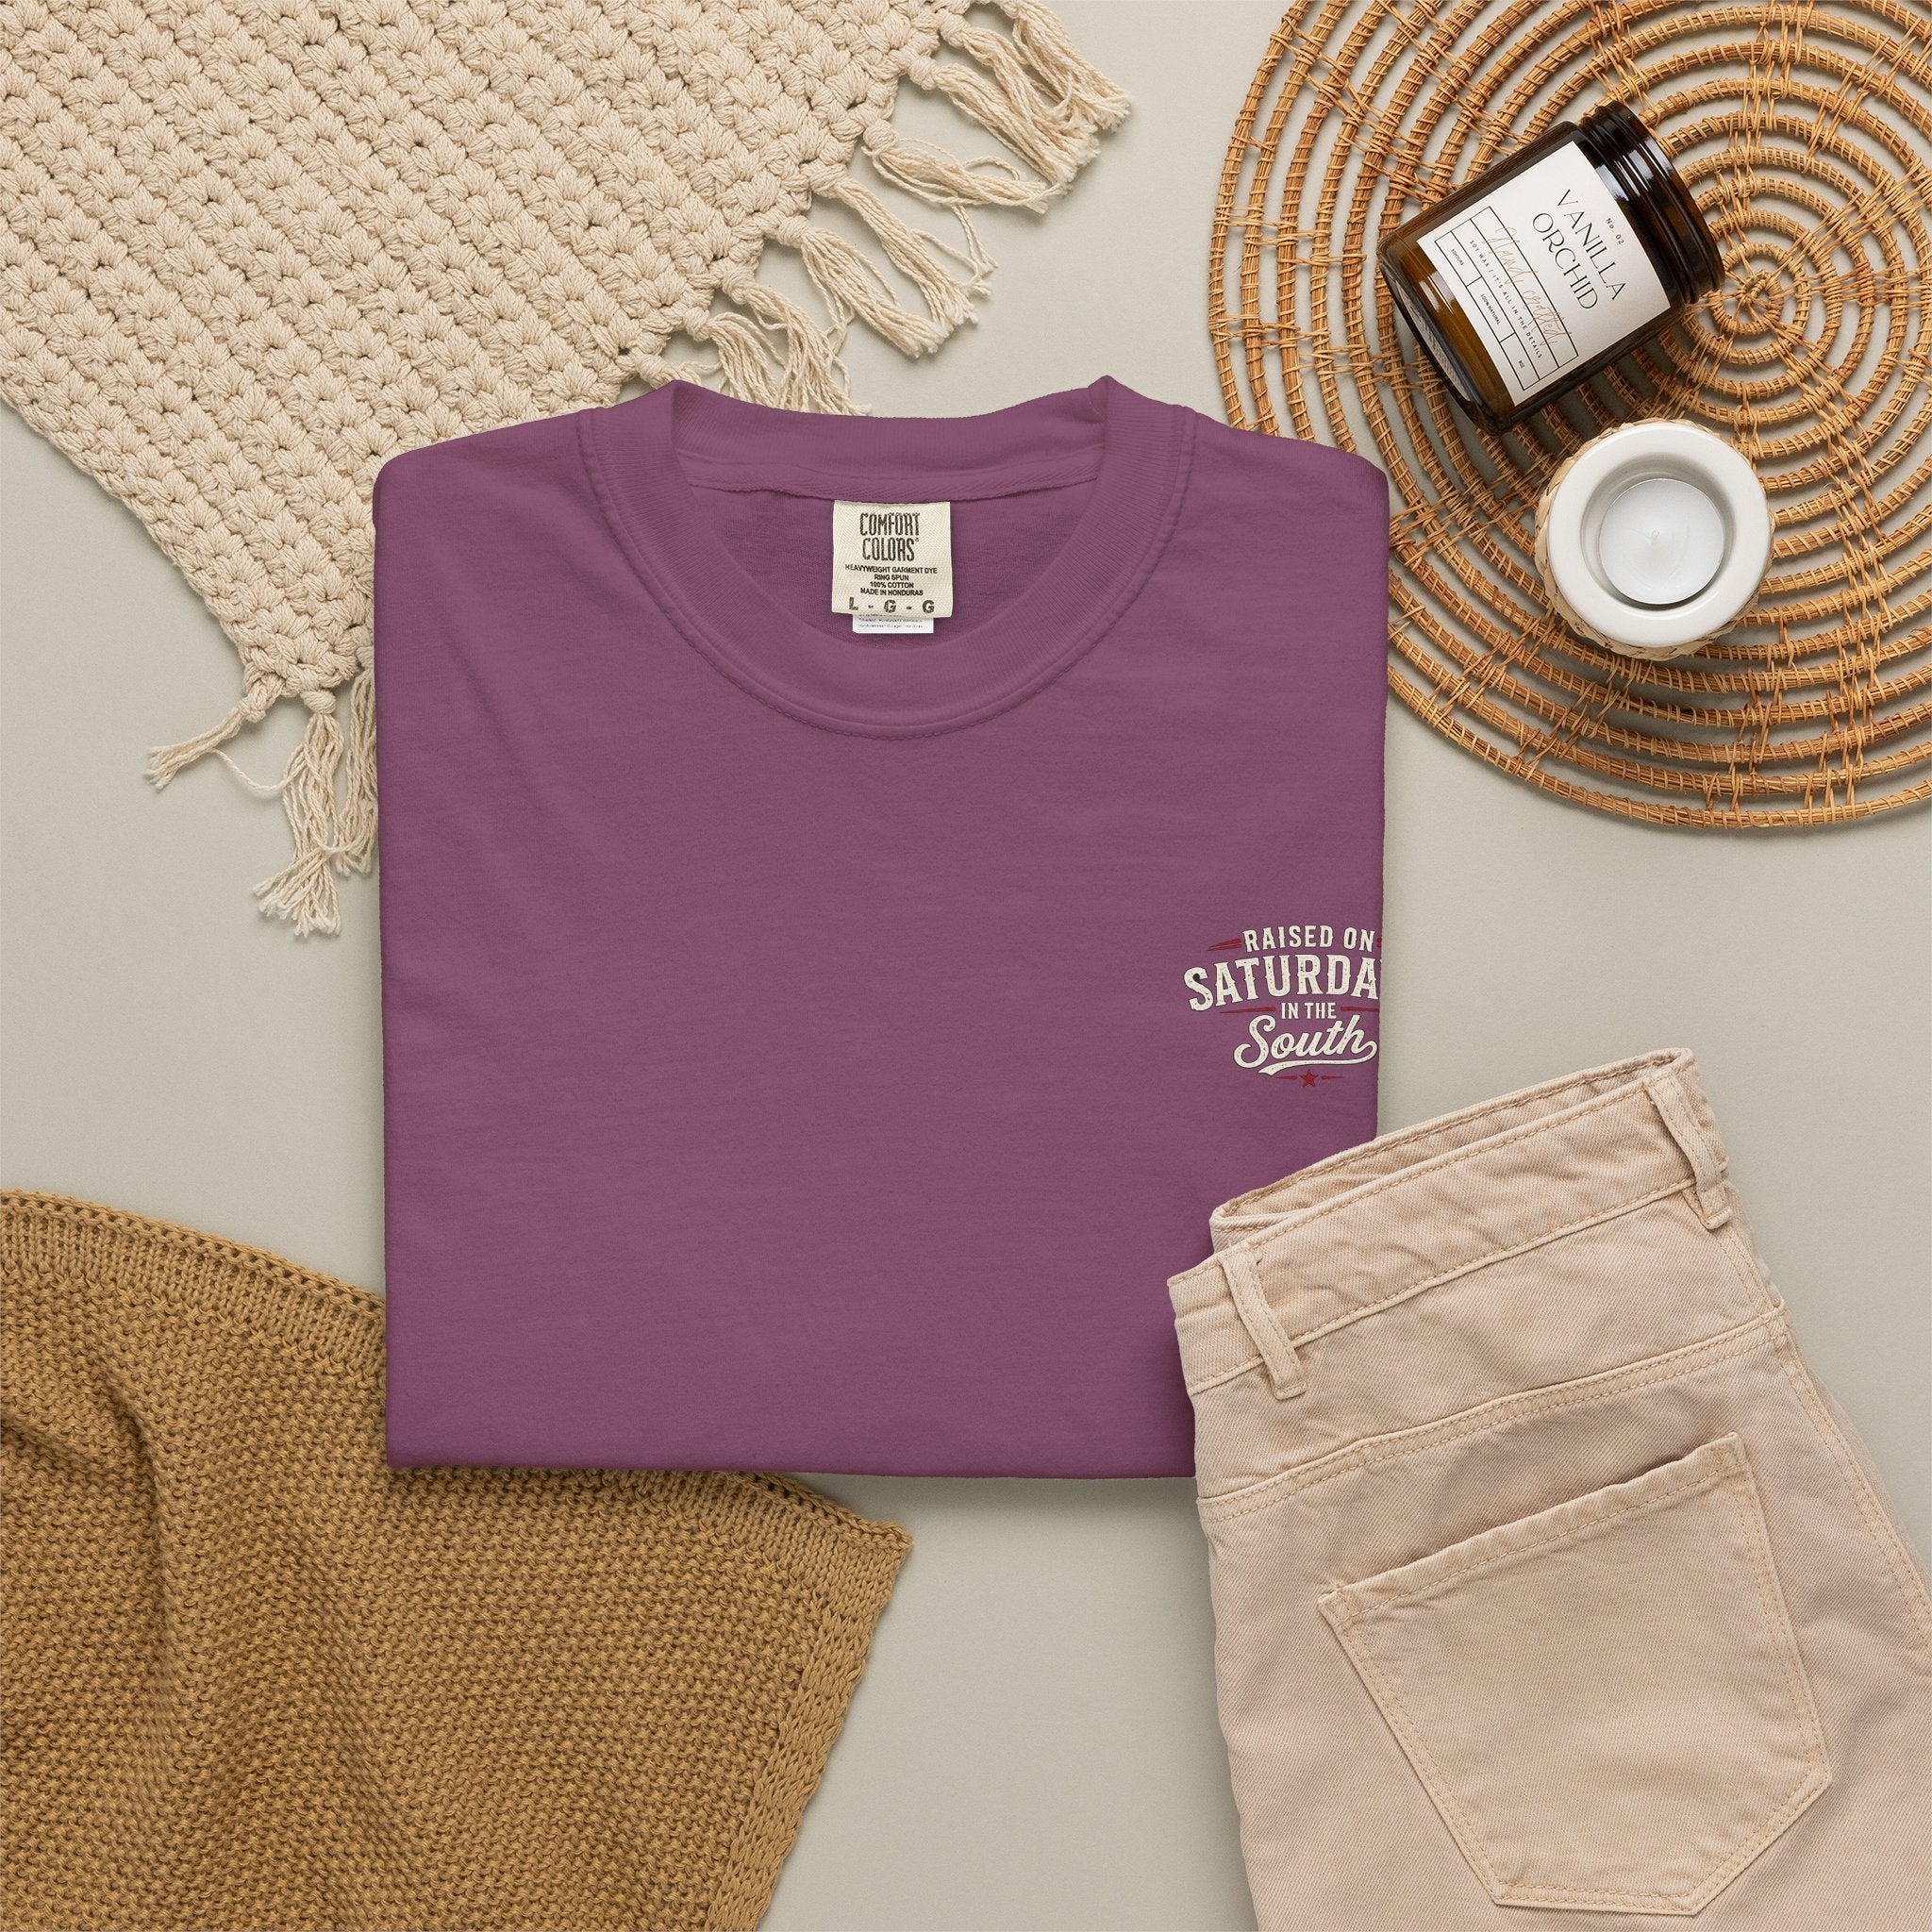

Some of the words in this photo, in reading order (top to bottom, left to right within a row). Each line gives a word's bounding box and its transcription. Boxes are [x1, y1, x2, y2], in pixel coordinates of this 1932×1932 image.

[1557, 189, 1626, 300] VANILLA
[1606, 218, 1615, 232] No.
[1615, 234, 1624, 244] 02
[1532, 213, 1598, 309] ORCHID
[1470, 240, 1479, 252] SOY
[1479, 254, 1489, 267] WAX
[1492, 275, 1503, 289] IT'S
[1503, 291, 1511, 304] ALL
[1511, 306, 1519, 315] IN
[1518, 316, 1527, 329] THE
[1526, 331, 1542, 358] DETAILS
[1488, 305, 1500, 325] NATURAL
[859, 512, 920, 536] COMFORT
[845, 564, 891, 573] HEAVYWEIGHT
[849, 596, 859, 610] L
[884, 599, 896, 613] G
[922, 600, 935, 613] G
[1242, 924, 1334, 952] RAISED
[1343, 926, 1375, 952] ON
[1184, 954, 1381, 1011] SATURDA
[1281, 1002, 1299, 1019] IN
[1304, 1002, 1337, 1019] THE
[1233, 1014, 1377, 1076] South
